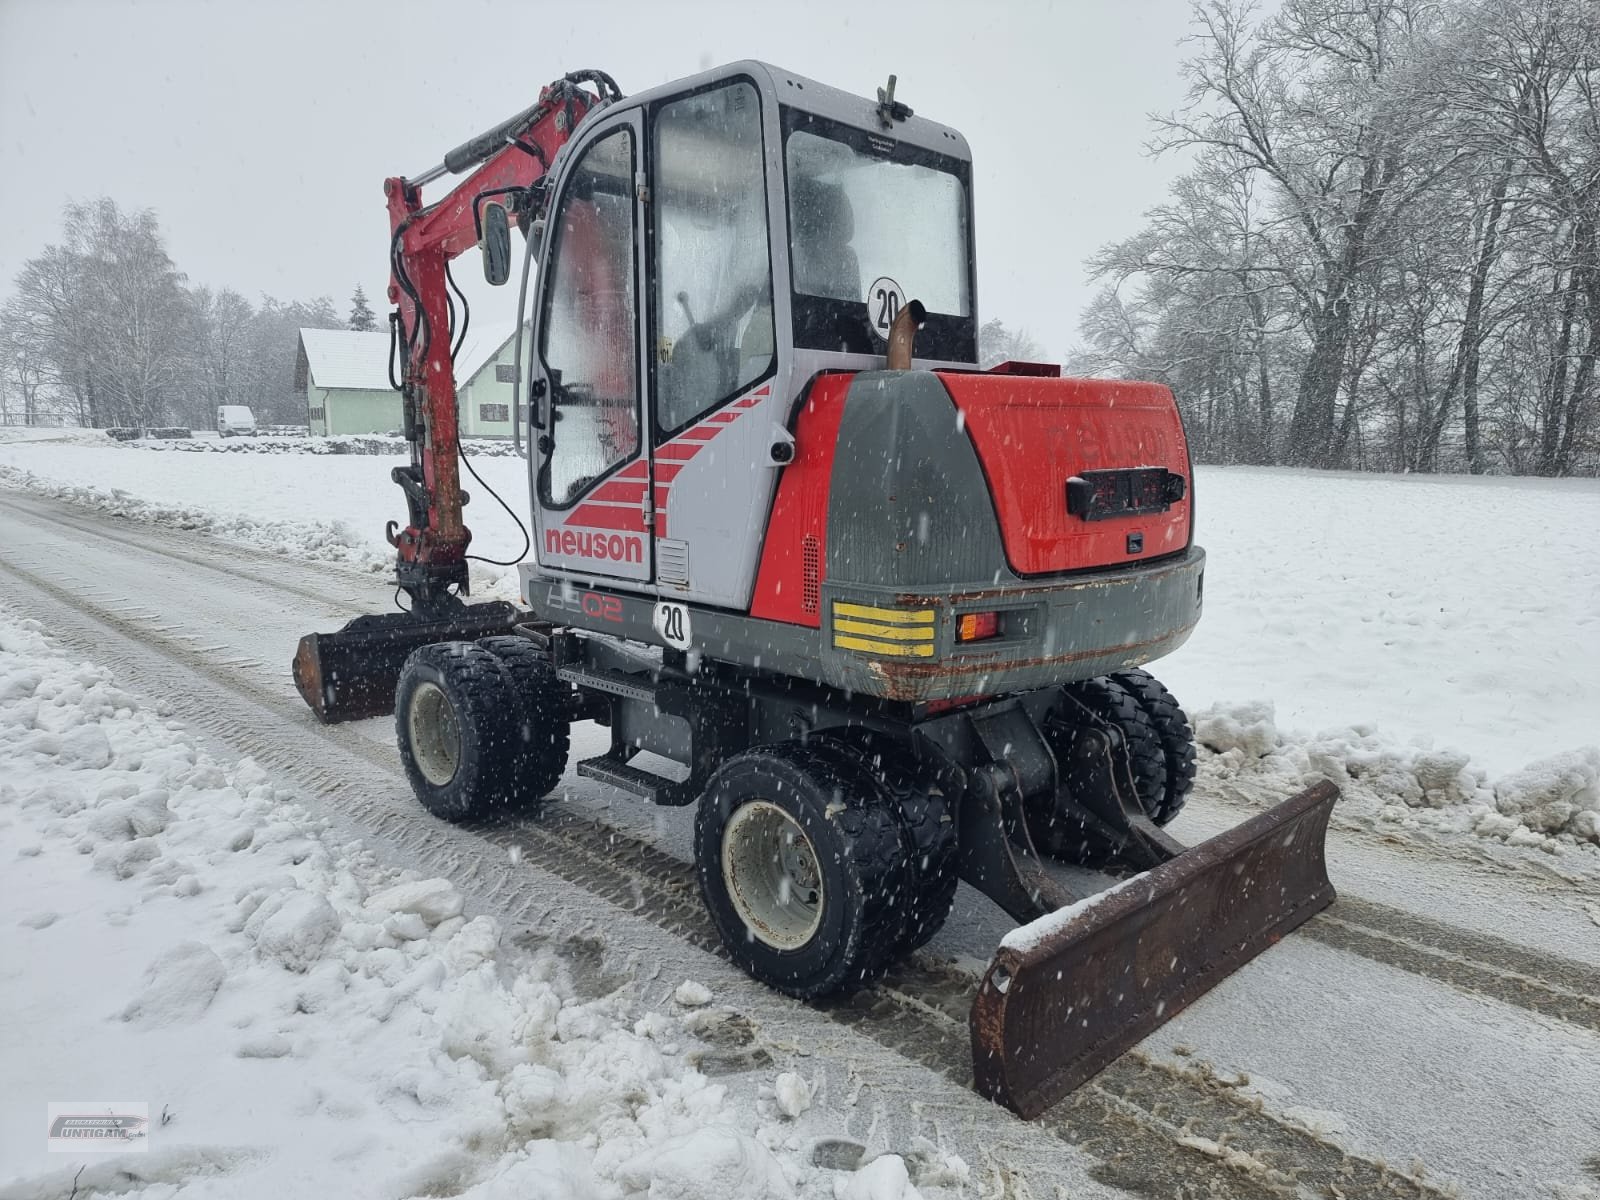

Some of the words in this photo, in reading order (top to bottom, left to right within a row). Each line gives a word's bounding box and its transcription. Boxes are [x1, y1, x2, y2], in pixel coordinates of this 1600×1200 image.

[876, 288, 899, 330] 20
[545, 528, 643, 563] neuson
[661, 605, 685, 642] 20
